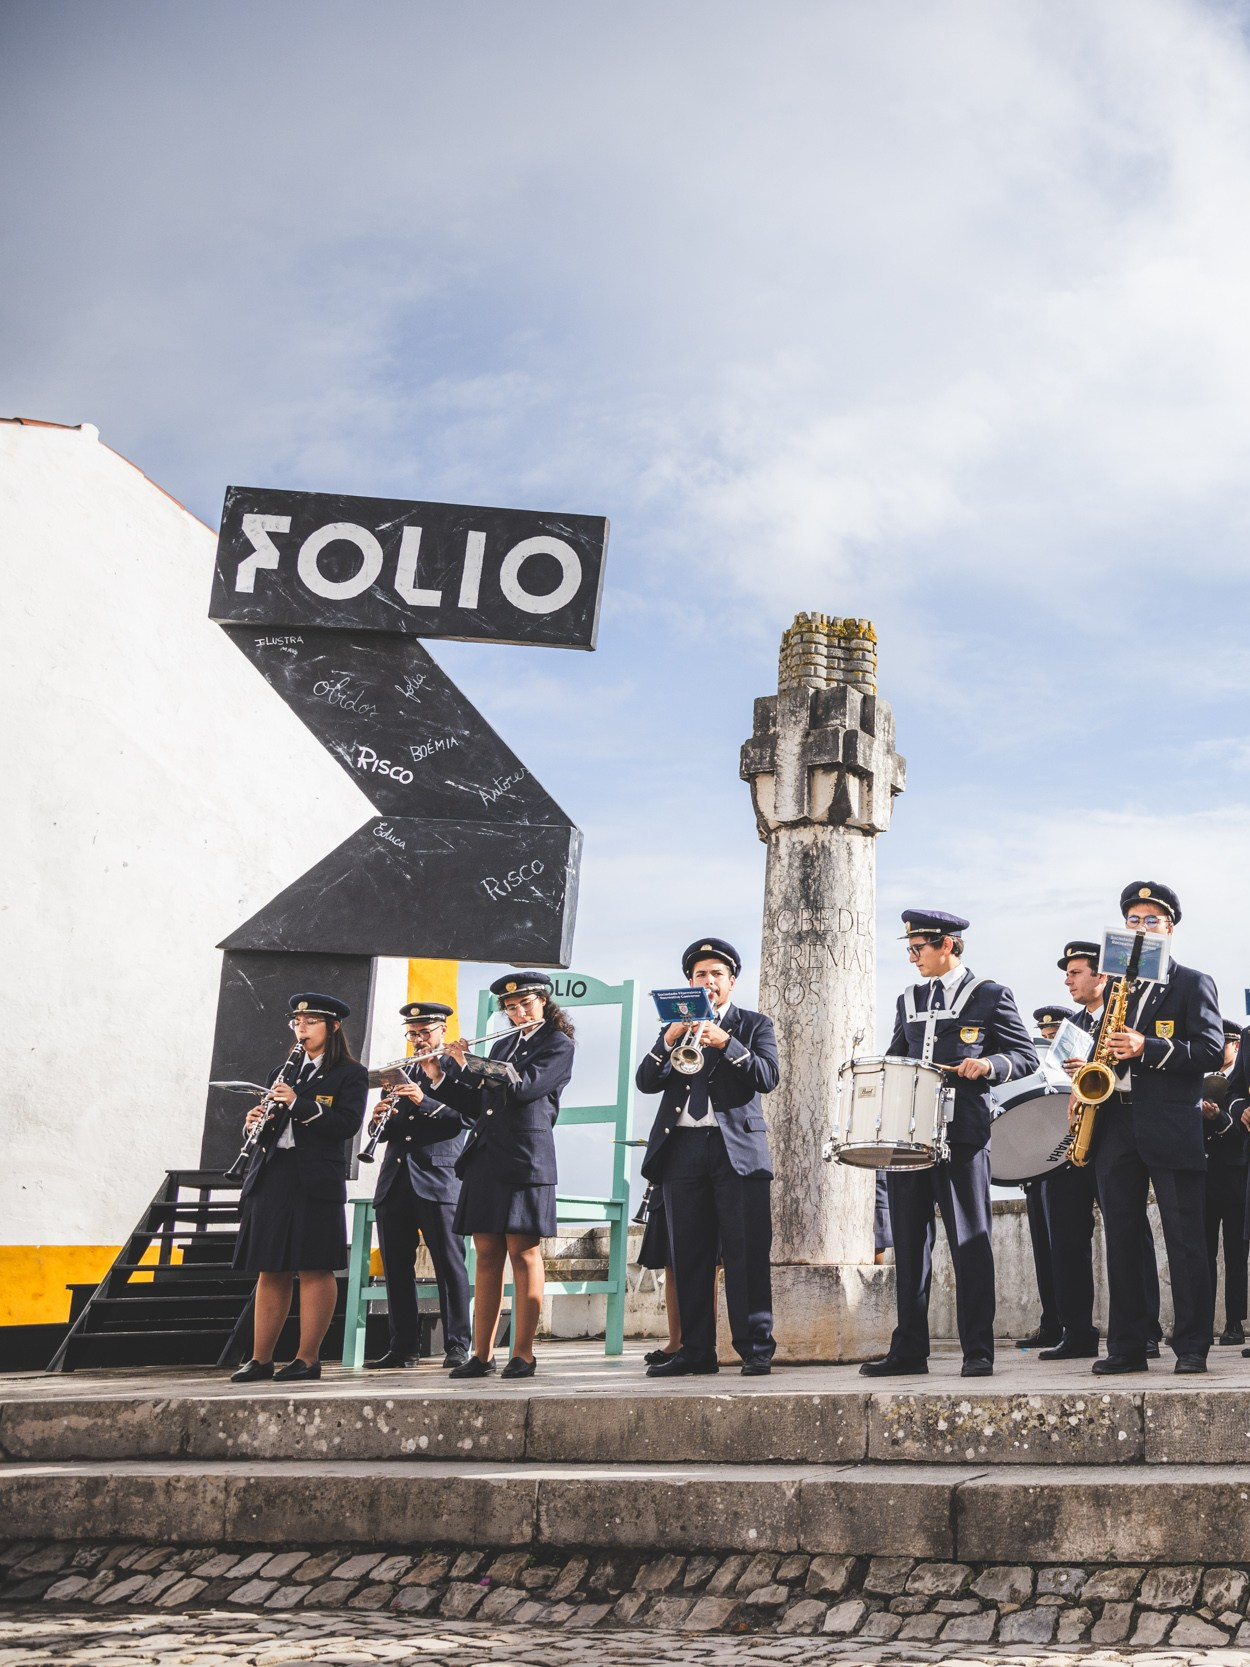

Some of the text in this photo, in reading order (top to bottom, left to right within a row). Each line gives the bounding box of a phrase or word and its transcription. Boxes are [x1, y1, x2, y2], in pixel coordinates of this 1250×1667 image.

[235, 513, 582, 614] FOLIO
[254, 635, 305, 647] ILUSTRA
[410, 736, 459, 762] BOÉMIA
[373, 821, 406, 850] Educa
